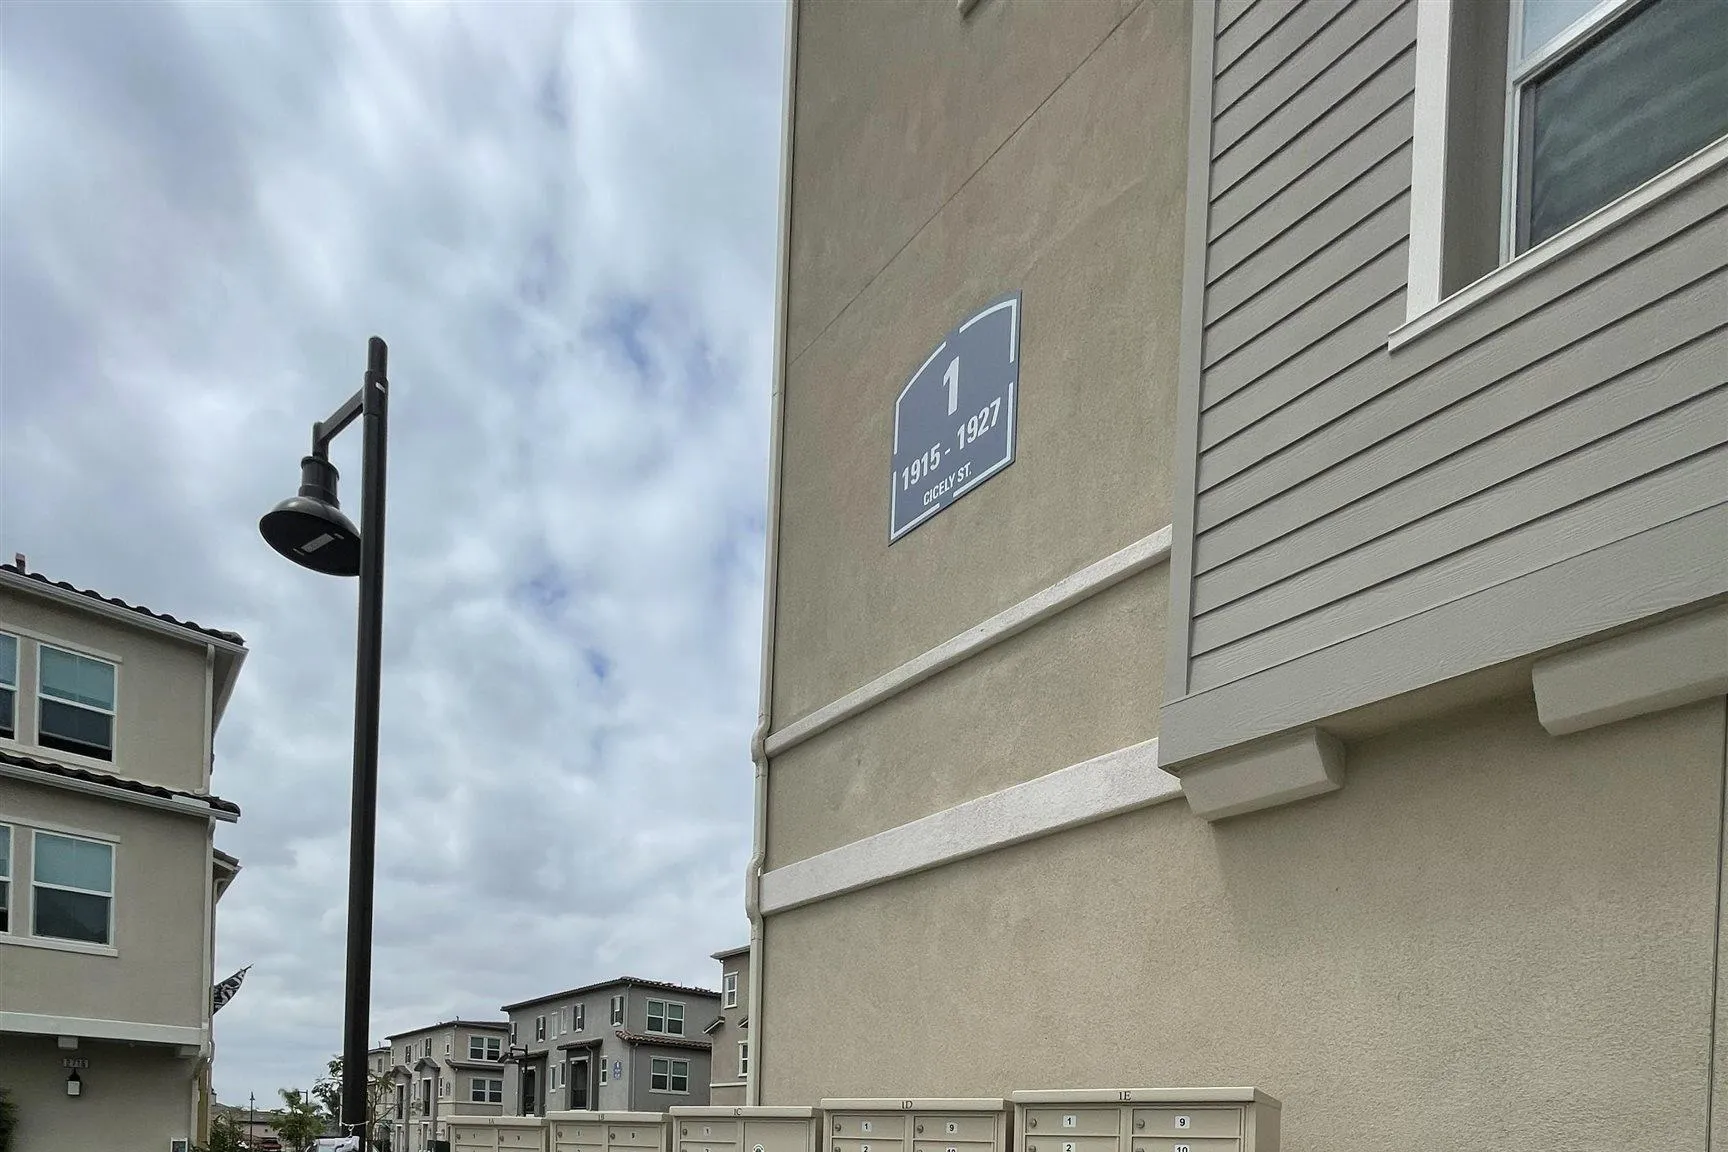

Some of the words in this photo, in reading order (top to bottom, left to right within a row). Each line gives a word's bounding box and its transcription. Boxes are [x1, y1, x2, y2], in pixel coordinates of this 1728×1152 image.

[942, 355, 960, 417] 1
[901, 442, 941, 491] 1915
[957, 396, 1002, 451] 1927
[923, 474, 956, 507] CICELY
[957, 461, 973, 484] ST.
[1119, 1091, 1132, 1101] 1E
[901, 1100, 913, 1110] 1D
[733, 1107, 742, 1116] 1C
[1067, 1117, 1072, 1125] 1
[1179, 1117, 1186, 1127] 9
[949, 1124, 955, 1132] 9
[1066, 1144, 1072, 1152] 2
